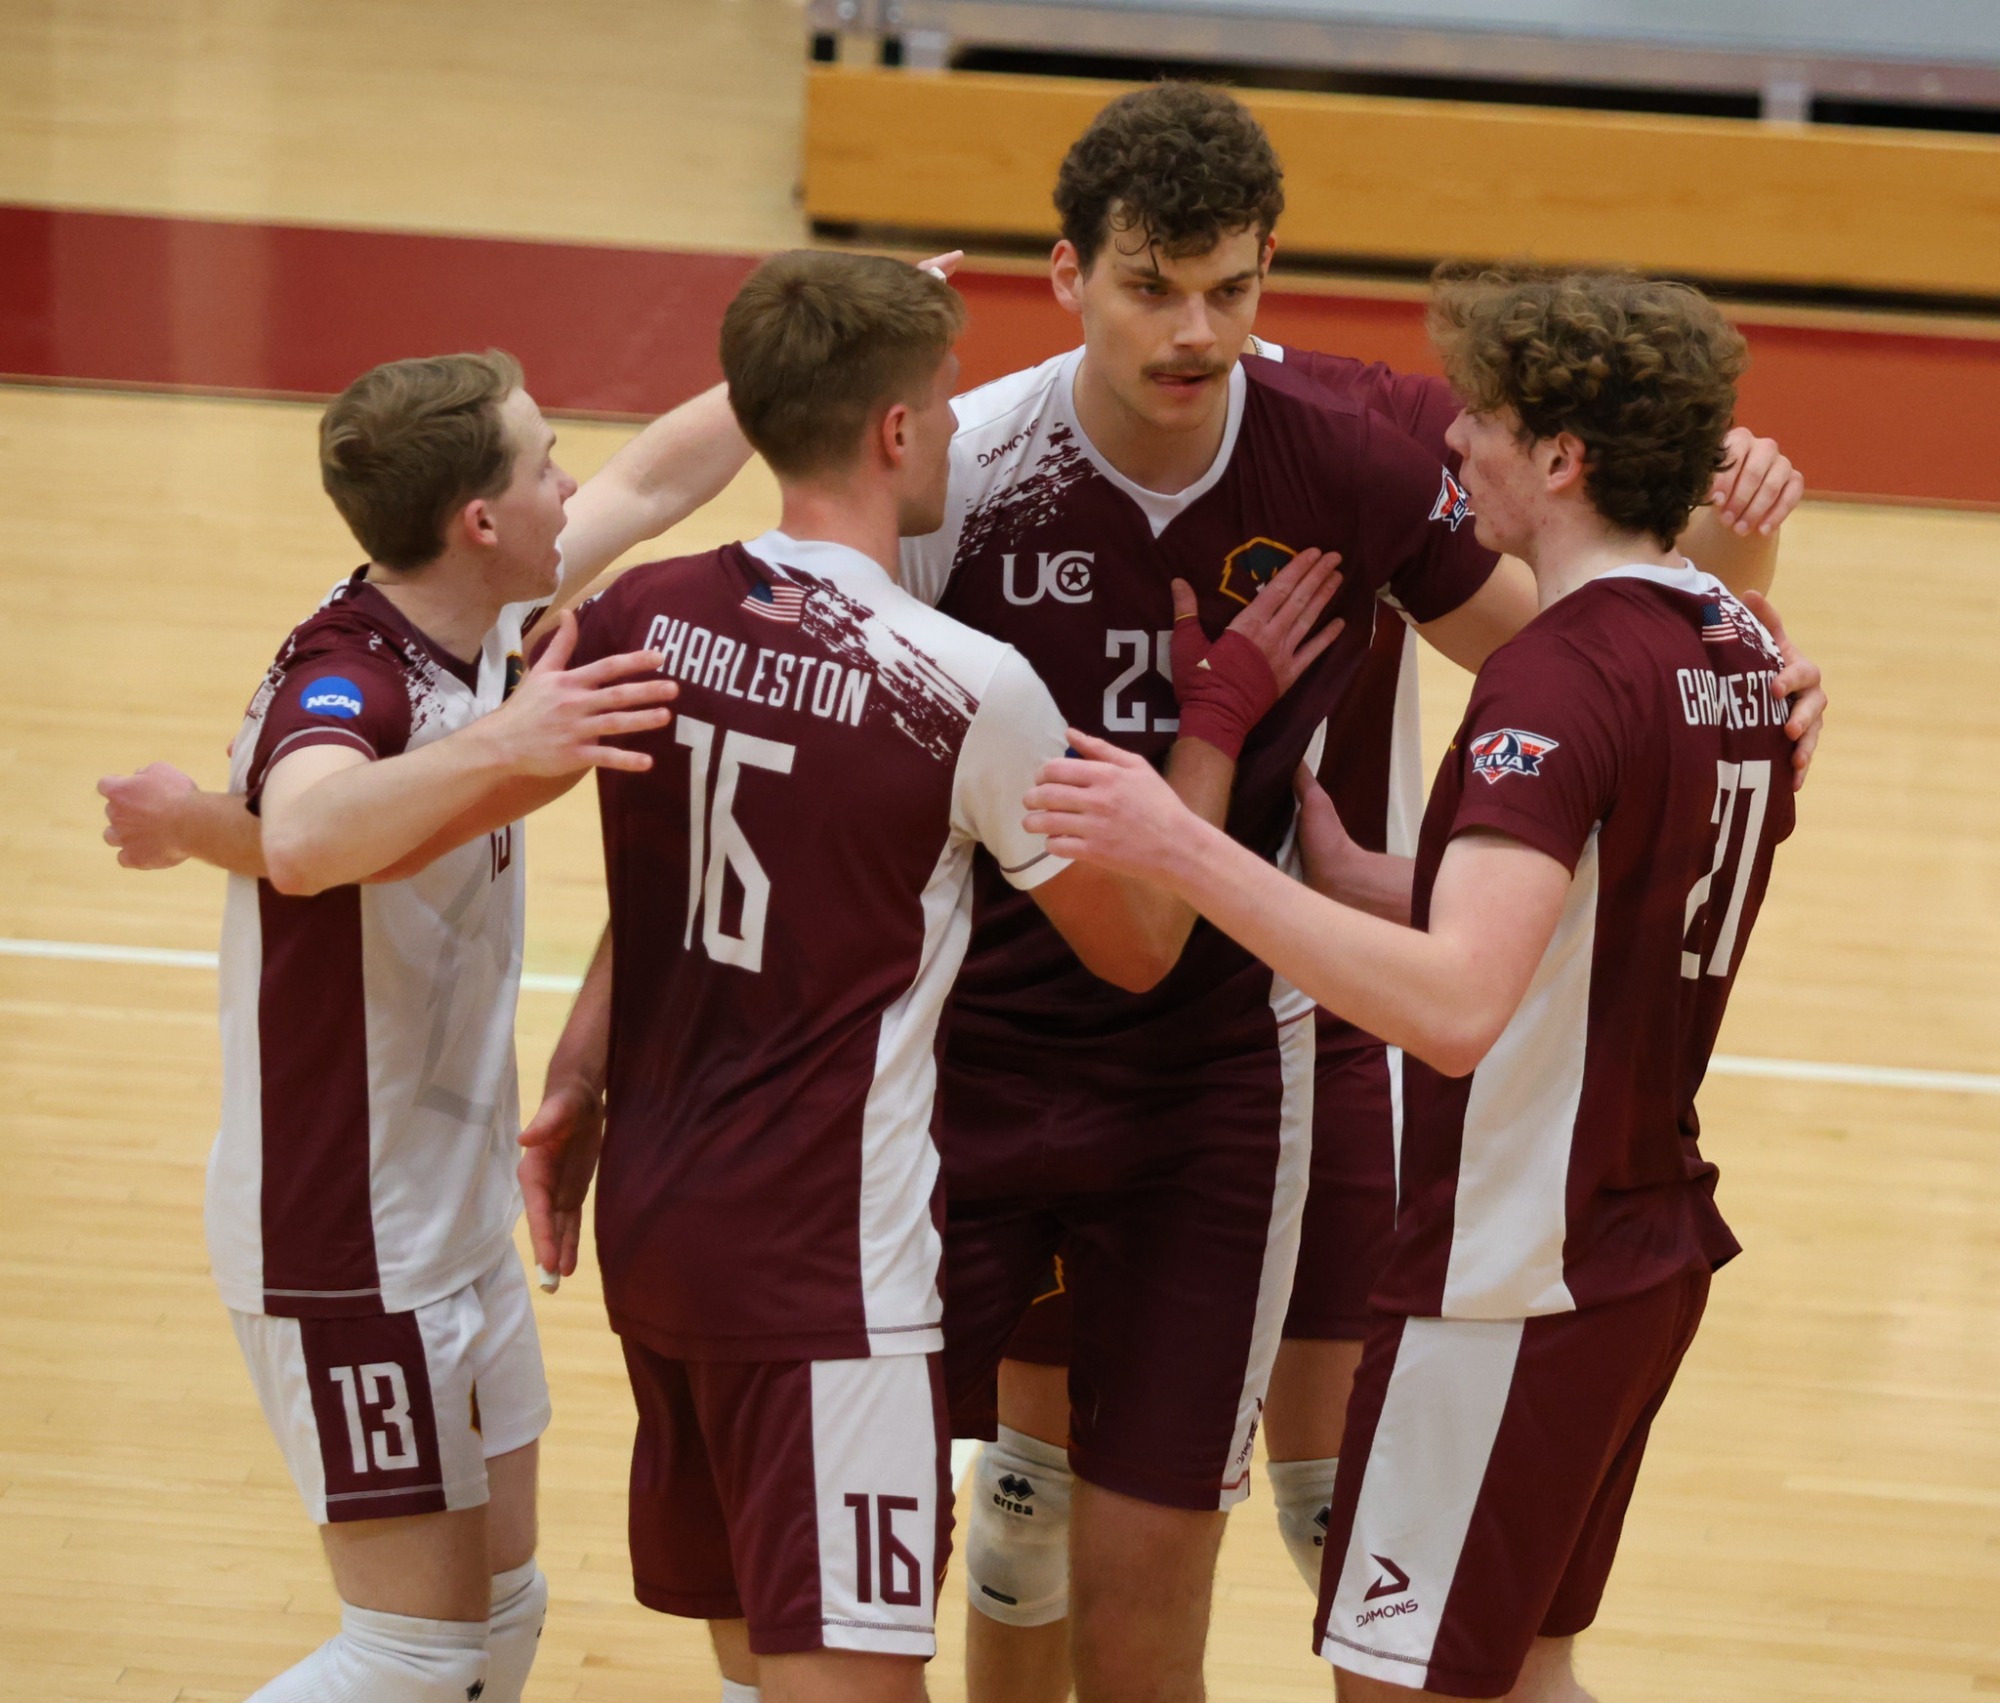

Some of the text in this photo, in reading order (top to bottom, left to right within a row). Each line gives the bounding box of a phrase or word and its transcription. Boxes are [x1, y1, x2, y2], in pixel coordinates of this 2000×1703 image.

[1001, 550, 1095, 606] UC
[306, 694, 361, 716] NCAA
[644, 614, 872, 727] CHARLESTON
[1474, 753, 1524, 770] EIVA
[674, 714, 796, 973] 16
[329, 1361, 419, 1474] 13
[843, 1492, 921, 1607] 16
[1356, 1599, 1418, 1628] DAMONS
